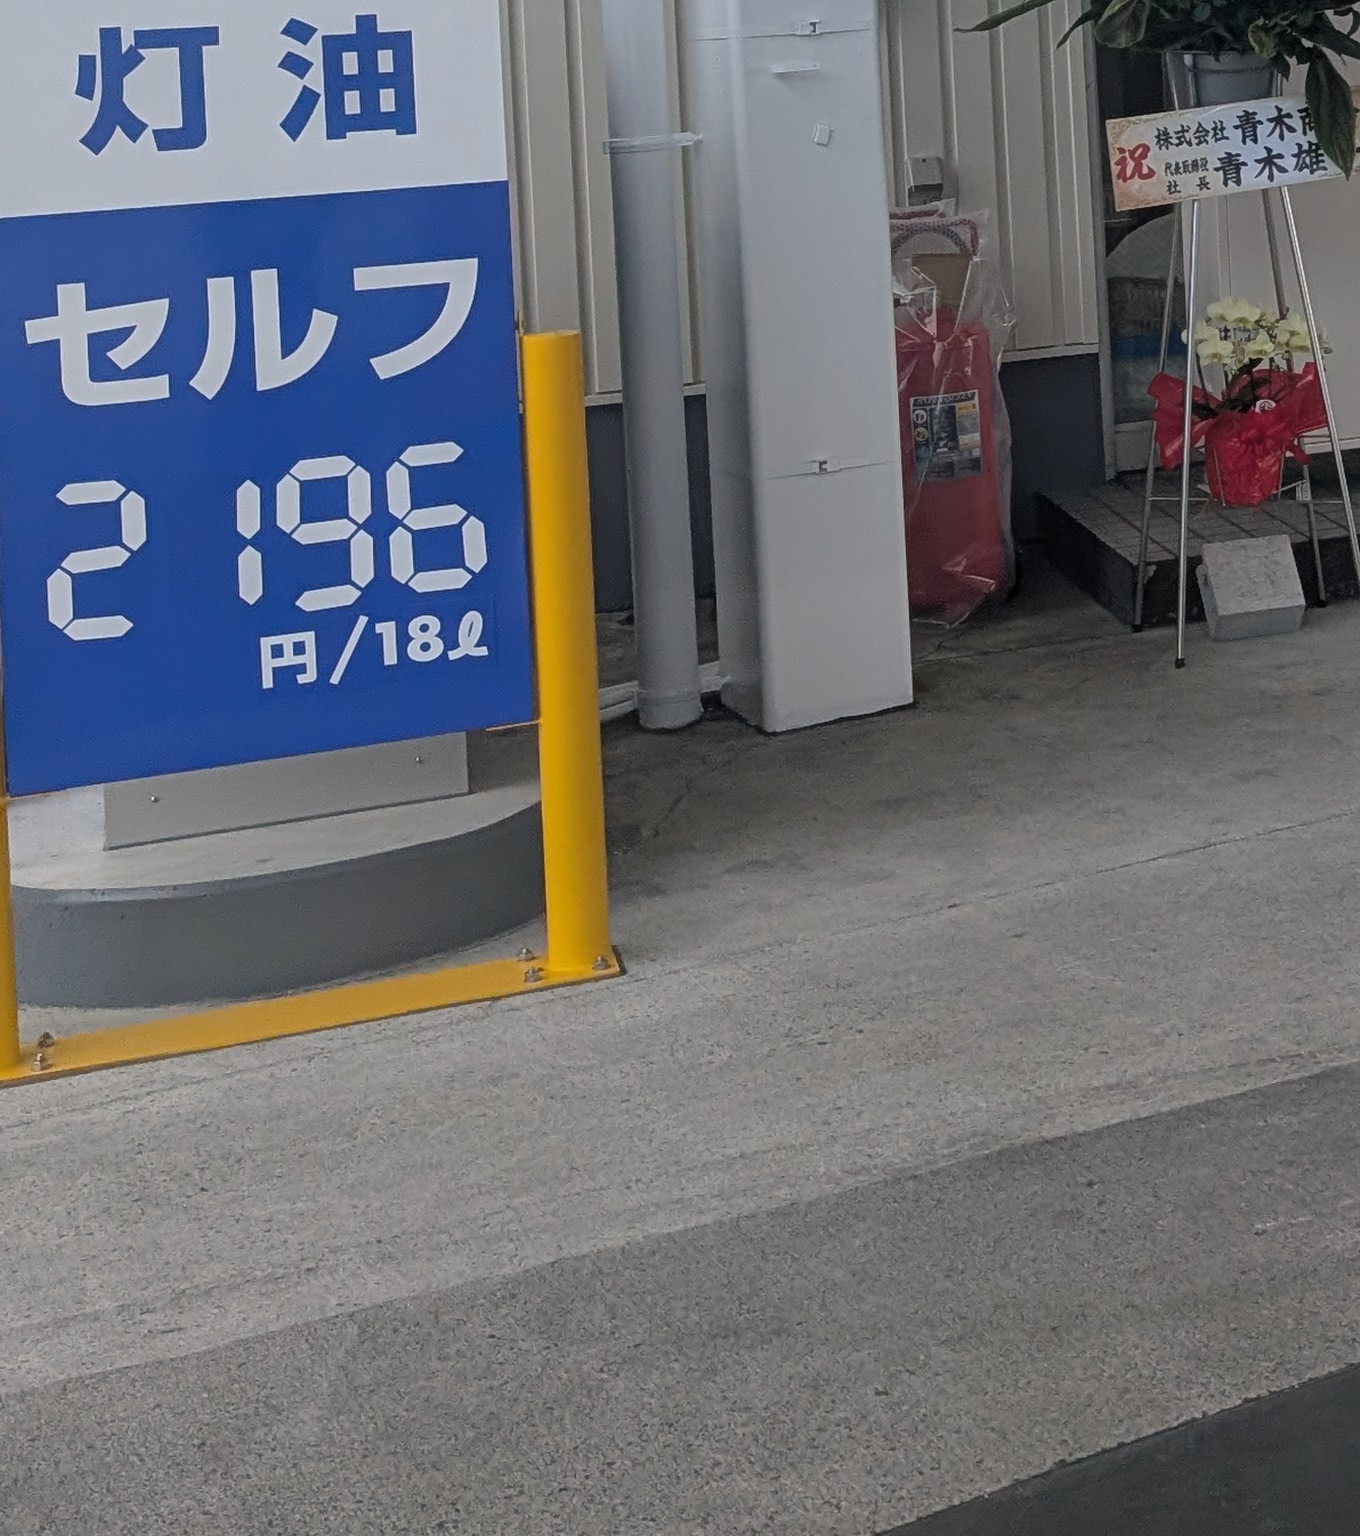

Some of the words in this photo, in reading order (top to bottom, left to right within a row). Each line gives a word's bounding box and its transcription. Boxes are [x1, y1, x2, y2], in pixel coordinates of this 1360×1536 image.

[74, 14, 419, 156] 灯油
[1114, 143, 1156, 184] 祝
[25, 257, 480, 406] セルフ
